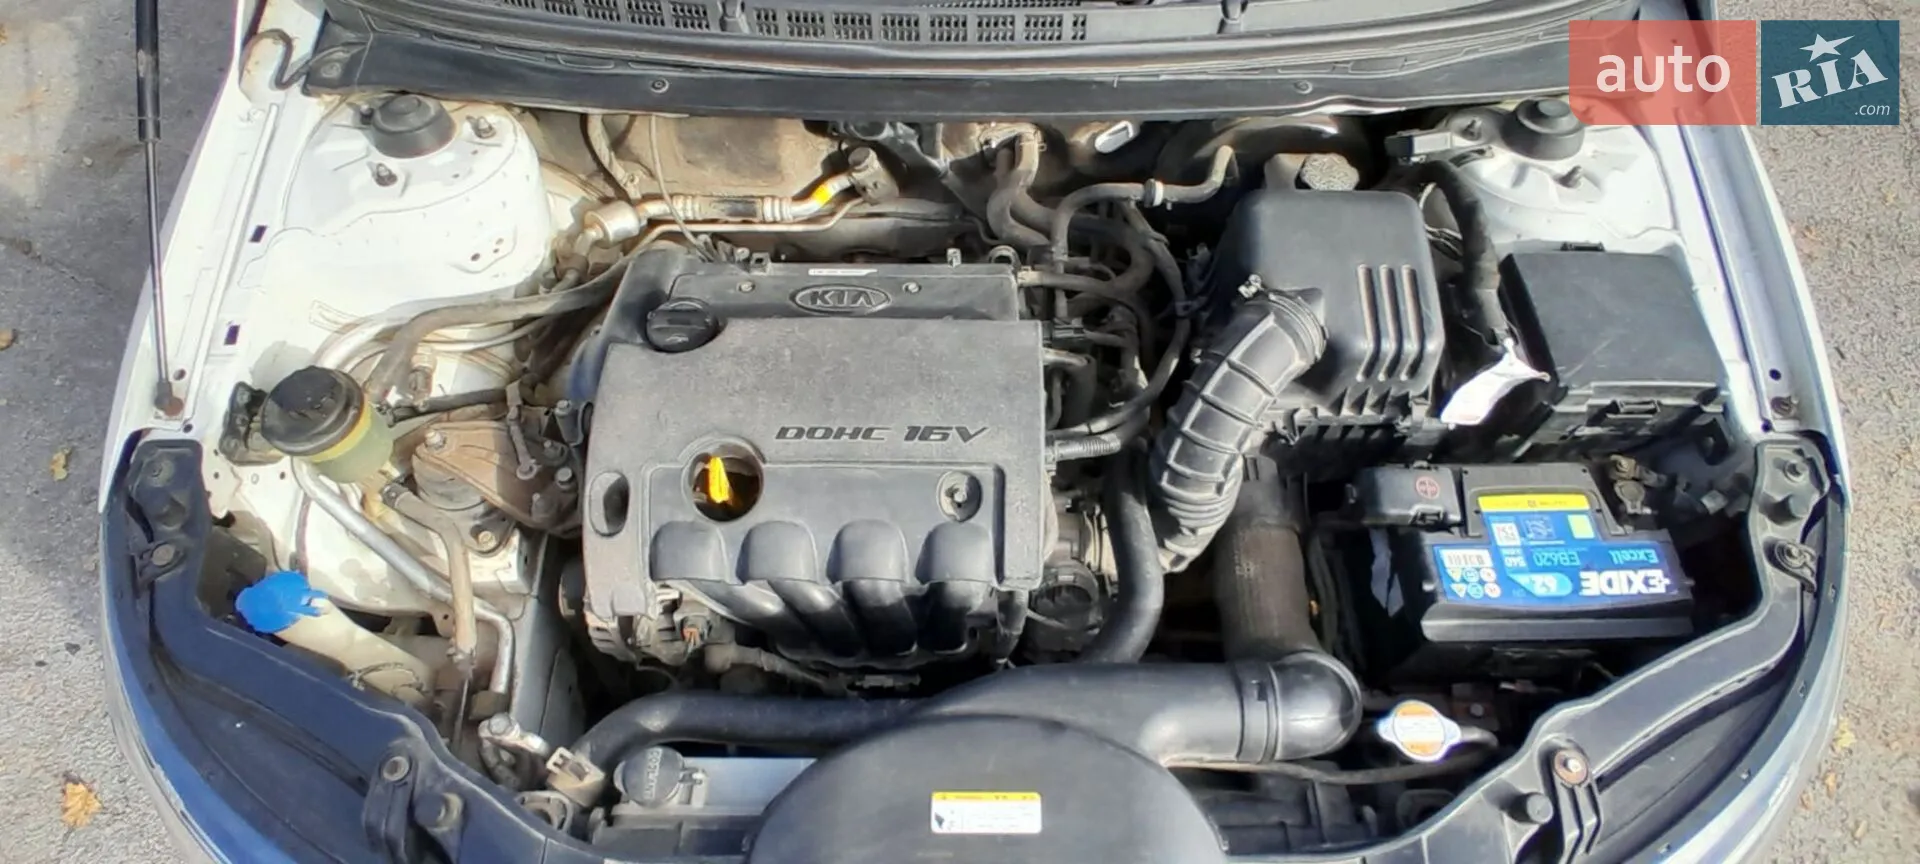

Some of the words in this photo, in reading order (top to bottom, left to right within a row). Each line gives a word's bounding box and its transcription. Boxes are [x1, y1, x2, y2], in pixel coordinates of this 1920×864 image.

[809, 289, 878, 307] KIA
[775, 426, 892, 441] DOHC
[903, 425, 989, 443] 16V
[1533, 550, 1581, 567] EB620
[1608, 548, 1660, 565] Excell
[1579, 568, 1671, 596] EXIDE
